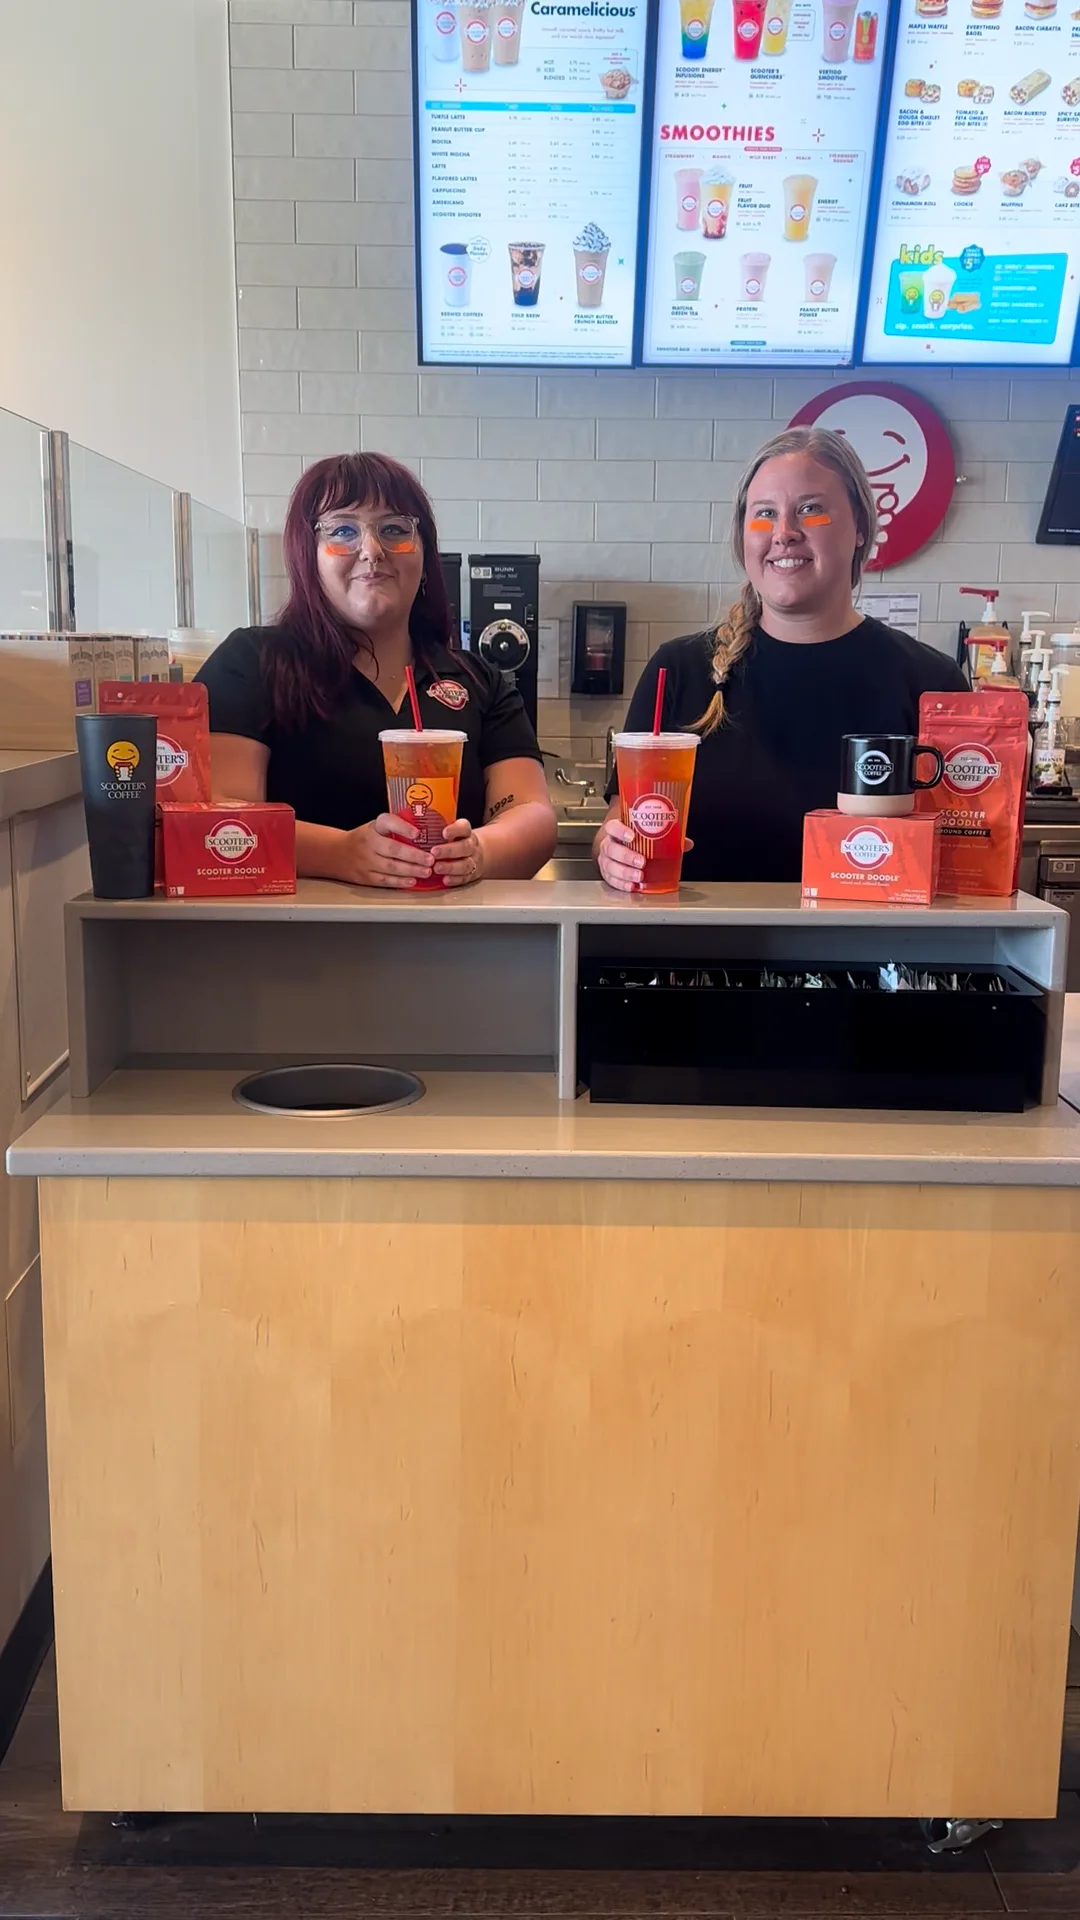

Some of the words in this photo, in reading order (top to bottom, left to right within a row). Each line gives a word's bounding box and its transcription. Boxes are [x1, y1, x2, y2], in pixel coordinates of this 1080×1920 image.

[531, 1, 636, 17] Caramelicious
[660, 124, 775, 142] SMOOTHIES
[899, 244, 944, 265] kids
[156, 754, 185, 764] TER'S
[856, 763, 892, 771] SCOOTER'S
[952, 774, 981, 782] COFFEE
[100, 782, 147, 791] SCOOTER'S
[108, 790, 141, 799] COFFEE
[489, 794, 515, 818] 1992
[632, 812, 676, 821] SCOOTER'S
[940, 809, 985, 819] SCOOTER
[208, 837, 255, 846] SCOOTER'S
[844, 844, 890, 852] SCOOTER'S
[197, 868, 232, 876] SCOOTER
[830, 872, 865, 880] SCOOTER
[867, 874, 899, 882] DOODLE
